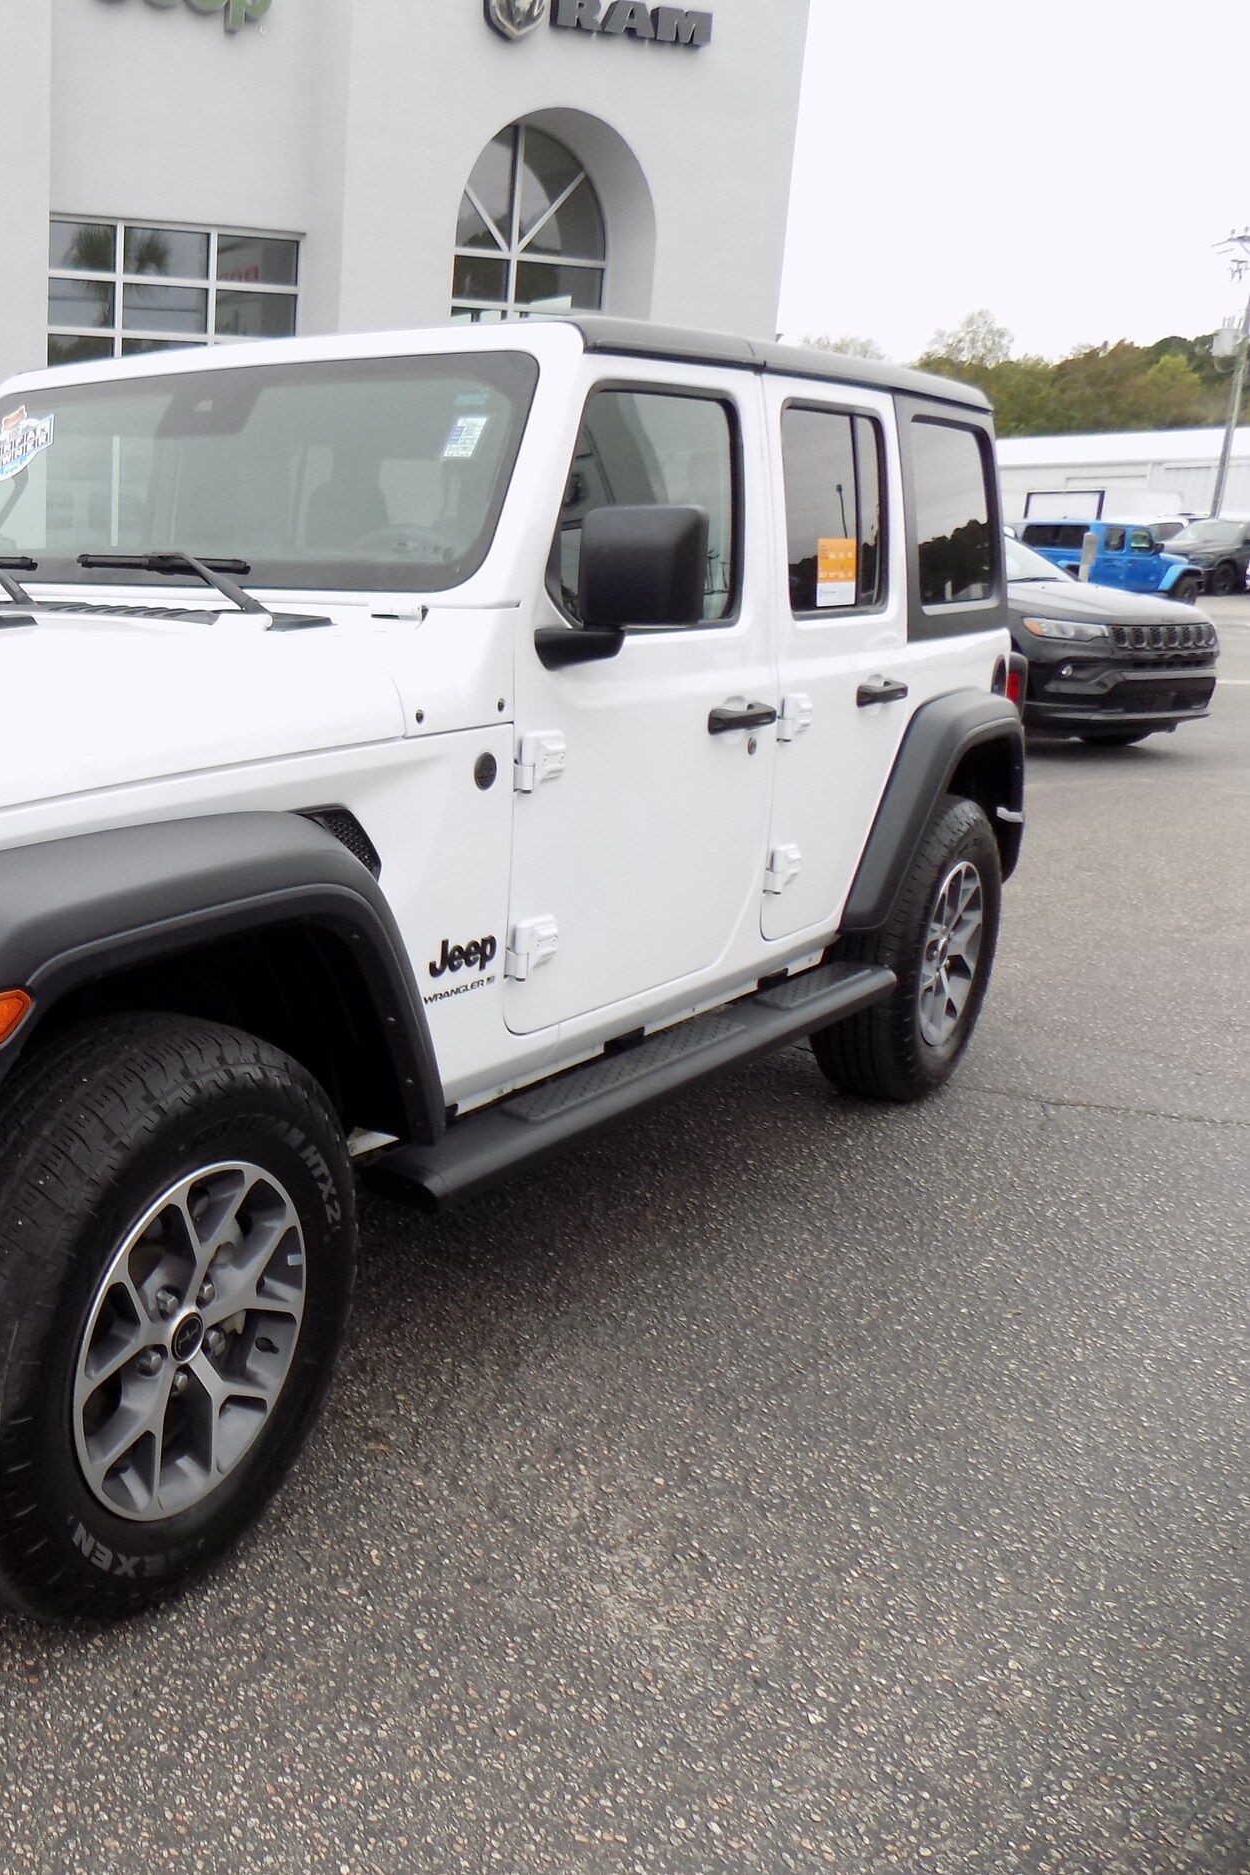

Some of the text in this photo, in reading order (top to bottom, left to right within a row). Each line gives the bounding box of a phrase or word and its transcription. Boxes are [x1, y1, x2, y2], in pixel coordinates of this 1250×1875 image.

[551, 0, 712, 46] RAM
[429, 935, 497, 978] Jeep
[423, 979, 485, 1005] WRANGLER
[299, 1144, 342, 1224] HTX2
